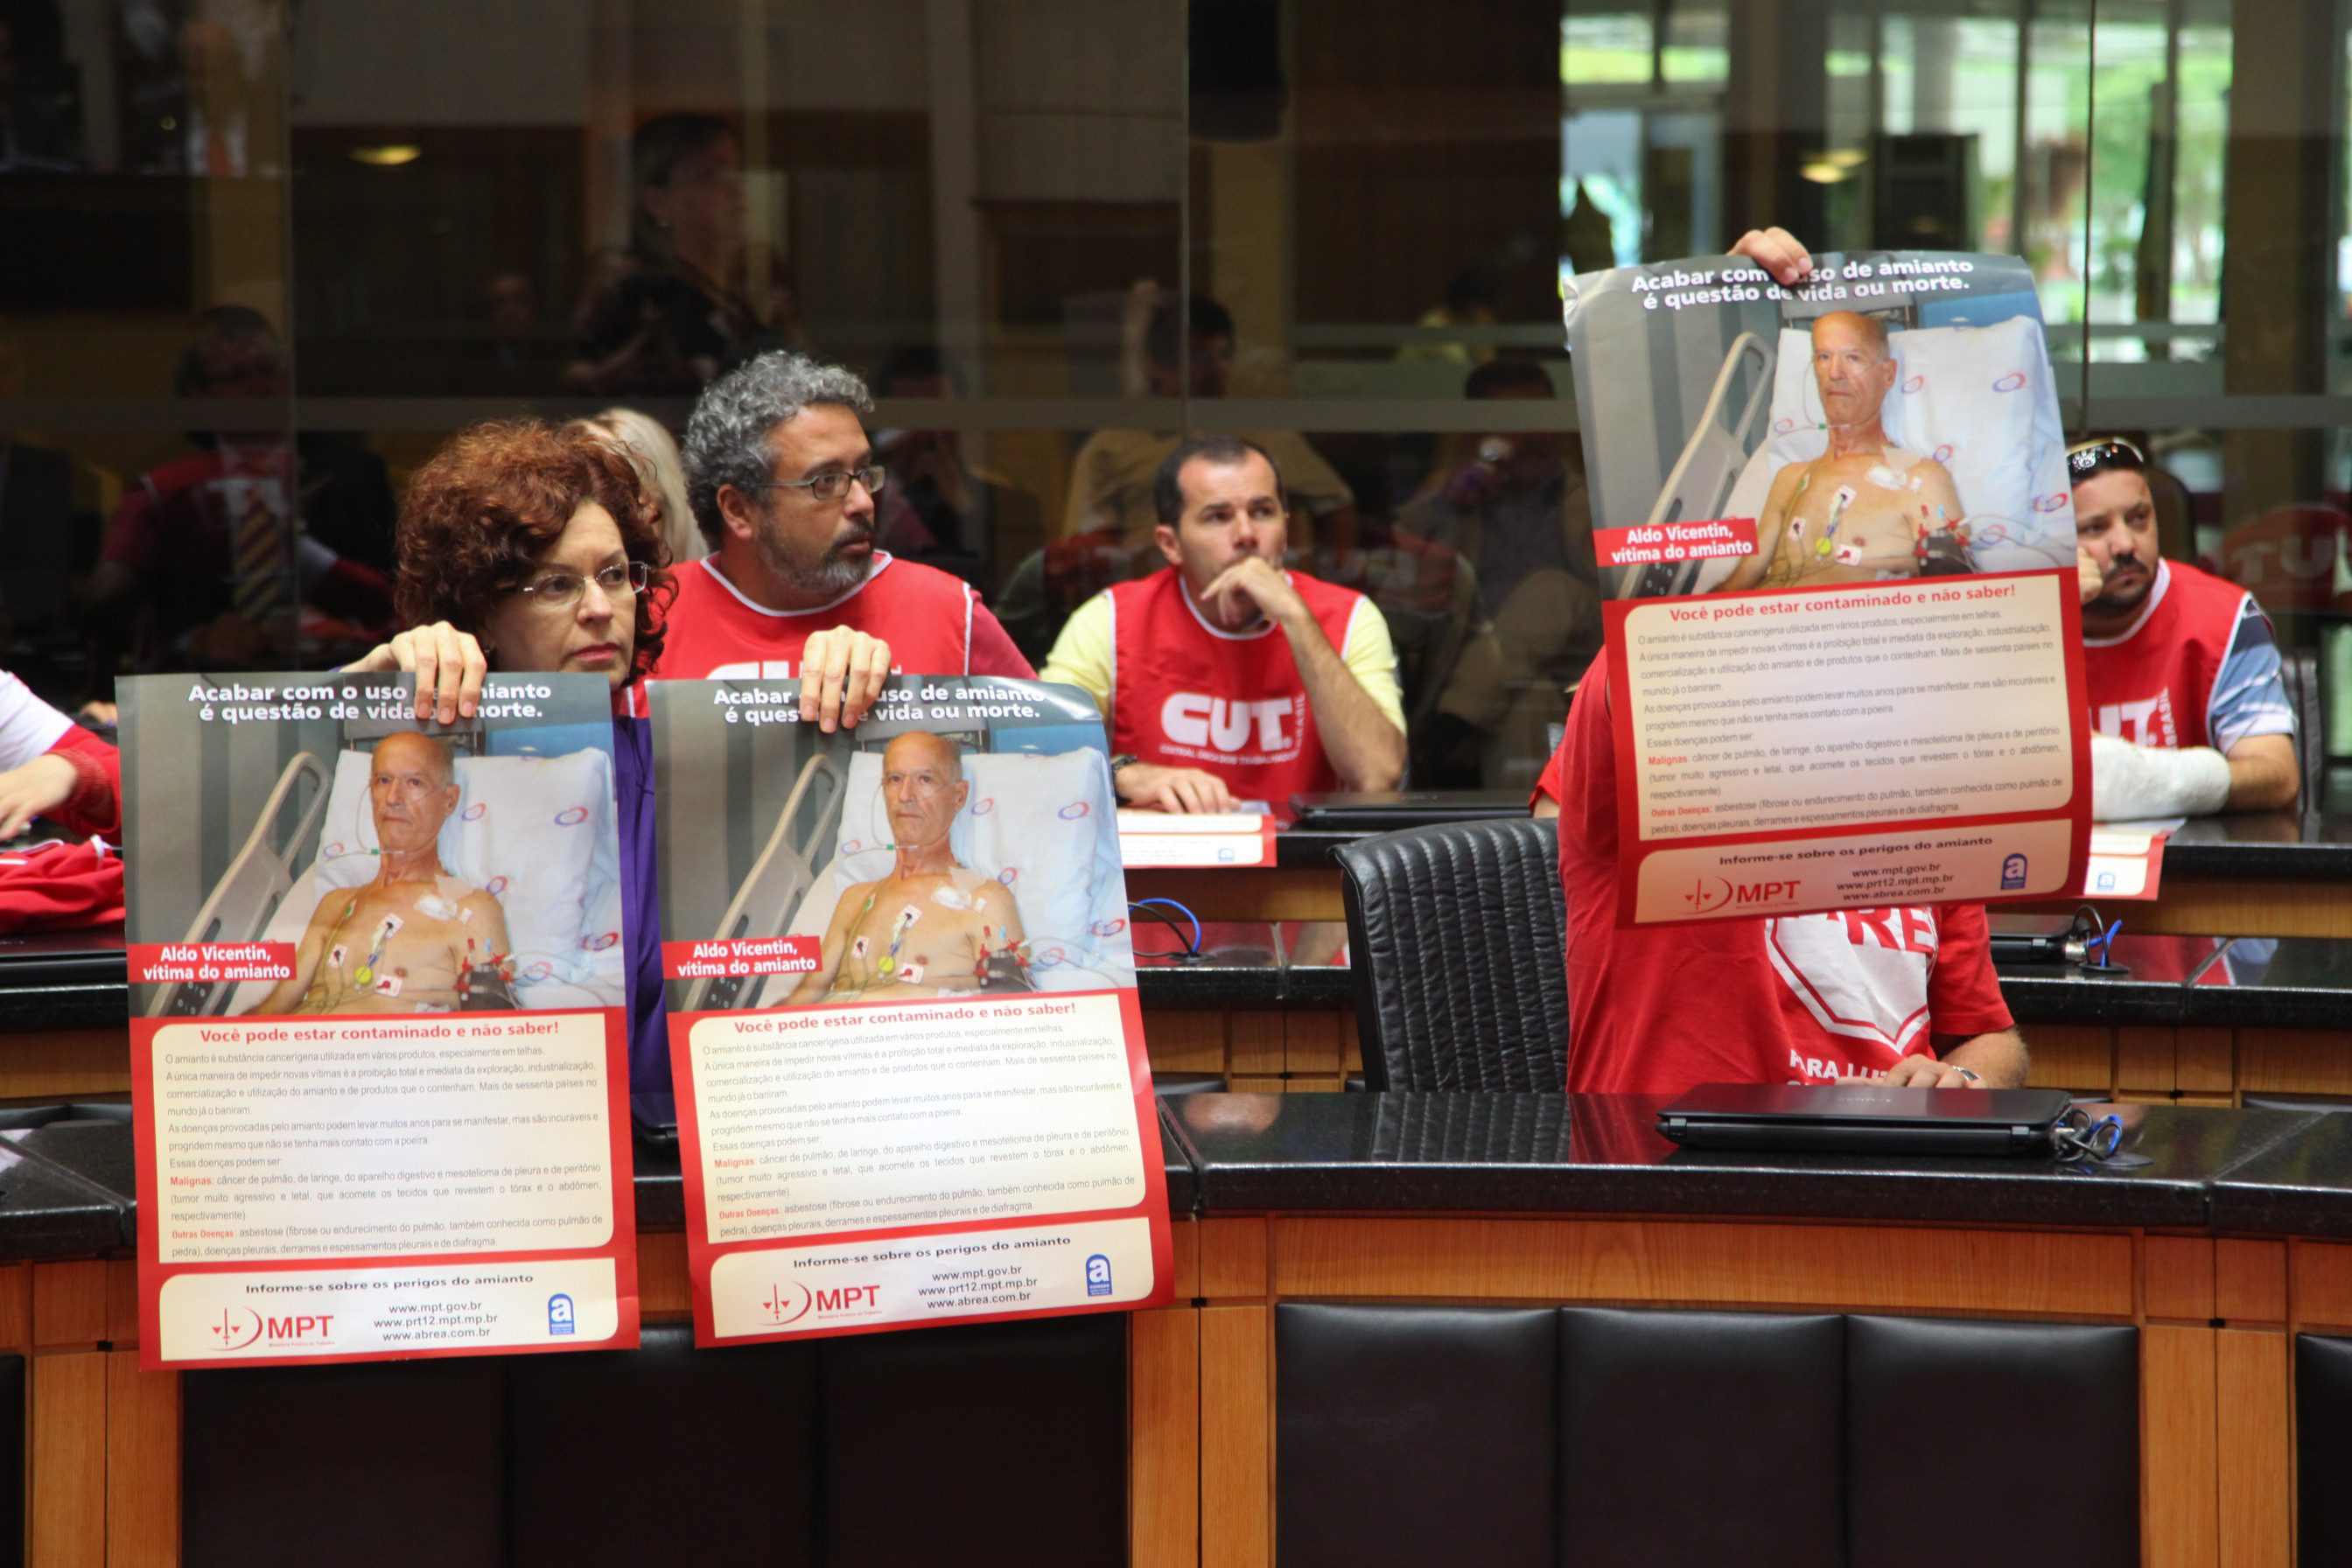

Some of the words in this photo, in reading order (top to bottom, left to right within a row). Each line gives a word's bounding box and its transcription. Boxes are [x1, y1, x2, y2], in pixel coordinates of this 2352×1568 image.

[1631, 270, 1714, 292] Acabar
[1721, 268, 1769, 283] com
[1843, 261, 1872, 279] de
[1880, 259, 1973, 276] amianto
[1643, 292, 1657, 309] é
[1664, 284, 1760, 310] questão
[1766, 285, 1792, 301] de
[1797, 284, 1846, 301] vida
[1855, 282, 1885, 297] ou
[1893, 276, 1969, 294] morte.
[1628, 528, 1662, 544] Aldo
[1666, 523, 1733, 541] Vicentin,
[1612, 547, 1661, 564] vítima
[1664, 544, 1685, 559] do
[1690, 541, 1752, 557] amianto
[1669, 606, 1708, 621] Você
[1712, 603, 1754, 621] pode
[1759, 601, 1800, 615] estar
[1804, 592, 1912, 612] contaminado
[1916, 593, 1926, 603] e
[1931, 589, 1961, 602] não
[1965, 584, 2014, 599] saber!
[188, 683, 275, 702] Acabar
[283, 686, 334, 700] com
[342, 686, 357, 699] o
[365, 686, 407, 700] uso
[481, 683, 551, 699] ianto
[714, 688, 791, 704] Acabar
[877, 689, 914, 702] uso
[920, 684, 948, 700] de
[956, 686, 1045, 702] amianto
[200, 704, 214, 721] é
[221, 703, 322, 724] questão
[329, 702, 359, 719] de
[366, 702, 416, 719] vida
[724, 707, 738, 723] é
[745, 709, 802, 726] ques
[875, 704, 922, 721] vida
[931, 707, 959, 719] ou
[967, 703, 1040, 718] morte.
[1160, 691, 1293, 752] CUT
[1719, 853, 1793, 865] Informe-se
[1797, 849, 1835, 859] sobre
[1858, 844, 1909, 857] perigos
[1914, 841, 1932, 850] do
[1936, 836, 1992, 849] amianto
[1737, 880, 1801, 903] MPT
[161, 946, 198, 961] Aldo
[201, 945, 271, 962] Vicentin,
[693, 942, 728, 958] Aldo
[732, 940, 798, 956] Vicentin,
[144, 964, 194, 980] vítima
[199, 964, 219, 979] do
[224, 963, 290, 979] amianto
[677, 961, 724, 976] vítima
[730, 959, 749, 974] do
[754, 957, 816, 973] amianto
[733, 1018, 773, 1033] Você
[777, 1016, 819, 1033] pode
[823, 1015, 864, 1027] estar
[868, 1007, 974, 1024] contaminado
[978, 1009, 988, 1018] e
[993, 1007, 1022, 1017] não
[1026, 1002, 1075, 1015] saber!
[200, 1028, 240, 1042] Você
[245, 1027, 288, 1045] pode
[293, 1028, 336, 1040] estar
[340, 1024, 452, 1040] contaminado
[456, 1027, 466, 1037] e
[471, 1024, 502, 1036] não
[507, 1021, 558, 1035] saber!
[248, 1174, 259, 1185] de
[297, 1172, 308, 1183] de
[344, 1172, 355, 1182] do
[357, 1171, 395, 1183] aparelho
[396, 1169, 435, 1182] digestivo
[444, 1168, 500, 1178] mesotelioma
[500, 1166, 512, 1176] de
[514, 1166, 541, 1178] pleura
[550, 1164, 562, 1174] de
[718, 1210, 745, 1220] Outras
[783, 1202, 827, 1214] asbestose
[829, 1199, 861, 1211] (fibrose
[875, 1192, 937, 1206] endurecimento
[938, 1191, 950, 1200] do
[1022, 1180, 1065, 1194] conhecida
[1067, 1180, 1090, 1190] como
[1124, 1174, 1135, 1185] de
[793, 1255, 868, 1268] Informe-se
[872, 1250, 911, 1261] sobre
[935, 1244, 987, 1257] perigos
[991, 1241, 1009, 1250] do
[1013, 1236, 1071, 1249] amianto
[245, 1284, 323, 1293] Informe-se
[327, 1281, 368, 1291] sobre
[393, 1278, 446, 1290] perigos
[451, 1276, 469, 1285] do
[474, 1274, 533, 1284] amianto
[932, 1265, 1022, 1281] www.mpt.gov.br
[918, 1278, 1037, 1296] www.prt12.mpt.mp.br
[388, 1301, 481, 1314] www.mpt.gov.br
[816, 1284, 880, 1312] MPT
[927, 1292, 1031, 1308] www.abrea.com.br
[268, 1315, 334, 1339] MPT
[373, 1313, 497, 1328] www.prt12.mpt.mp.br
[382, 1326, 490, 1340] www.abrea.com.br
